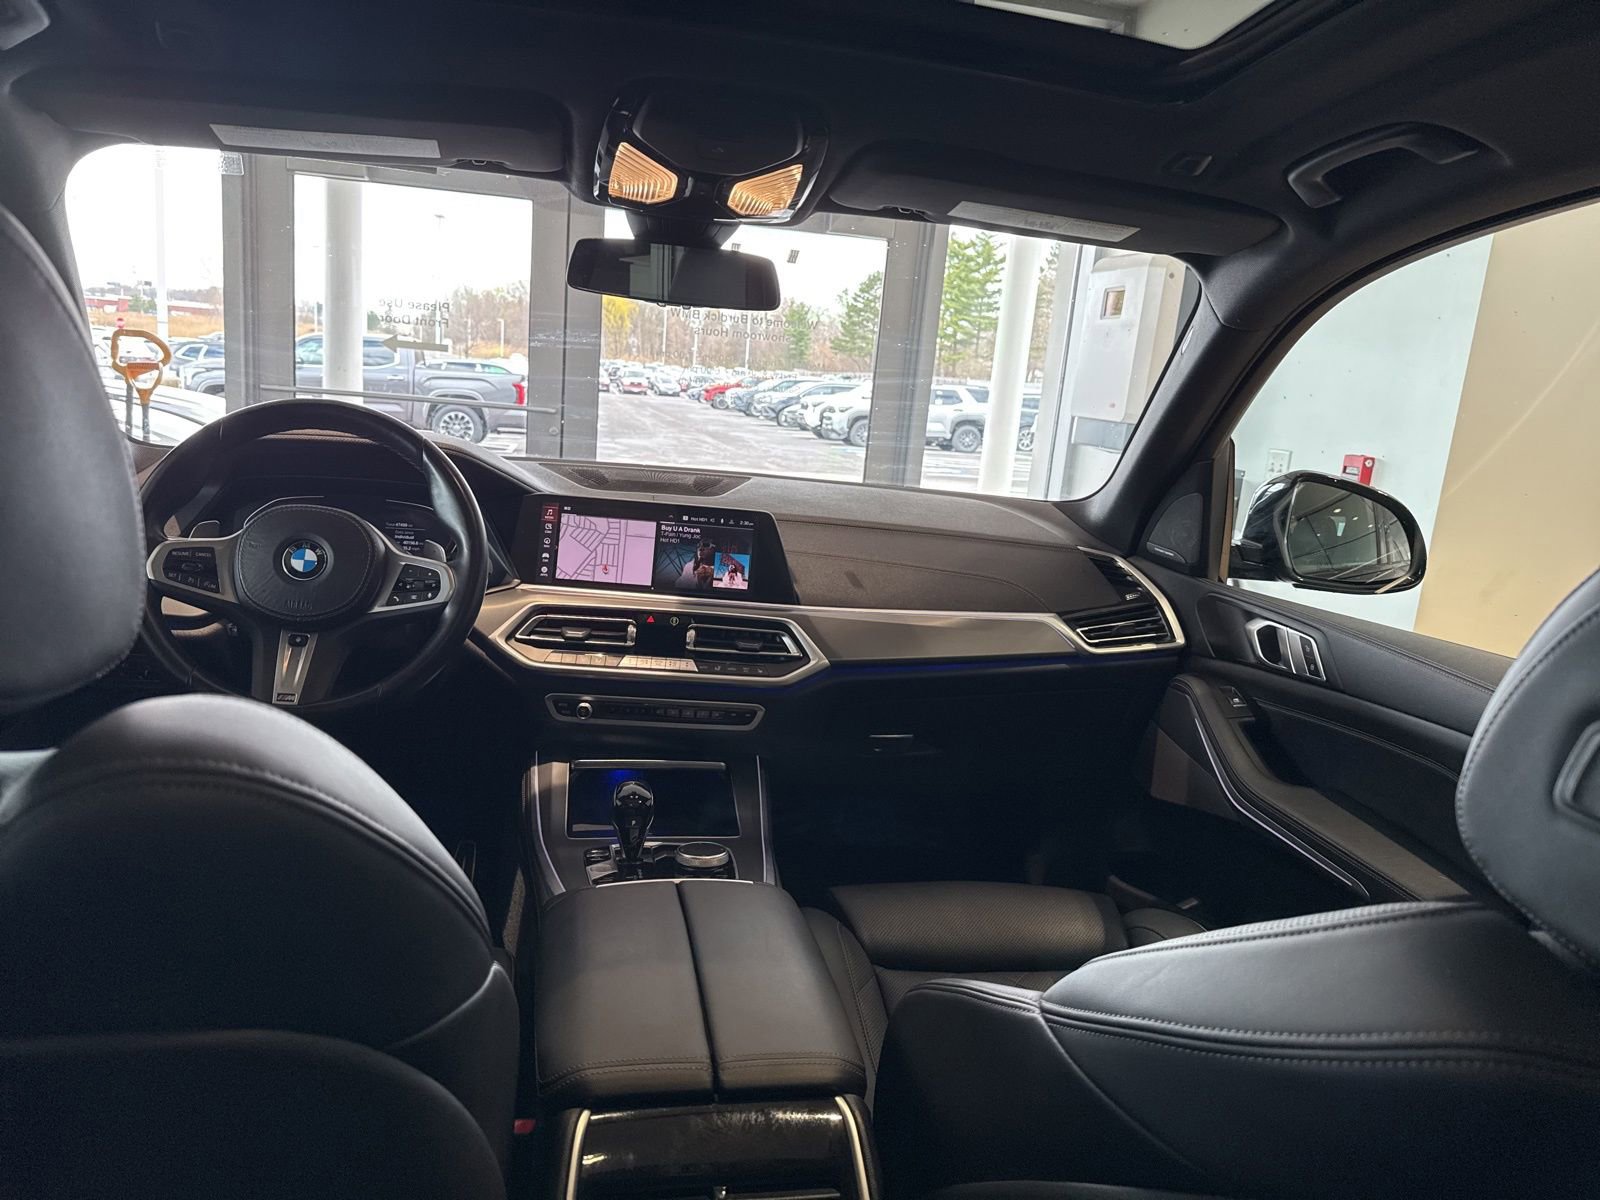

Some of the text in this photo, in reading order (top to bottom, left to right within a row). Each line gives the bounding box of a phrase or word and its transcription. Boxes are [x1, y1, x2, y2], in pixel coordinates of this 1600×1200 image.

[661, 525, 673, 533] Buy
[683, 526, 701, 534] Drank
[289, 542, 324, 556] BMW
